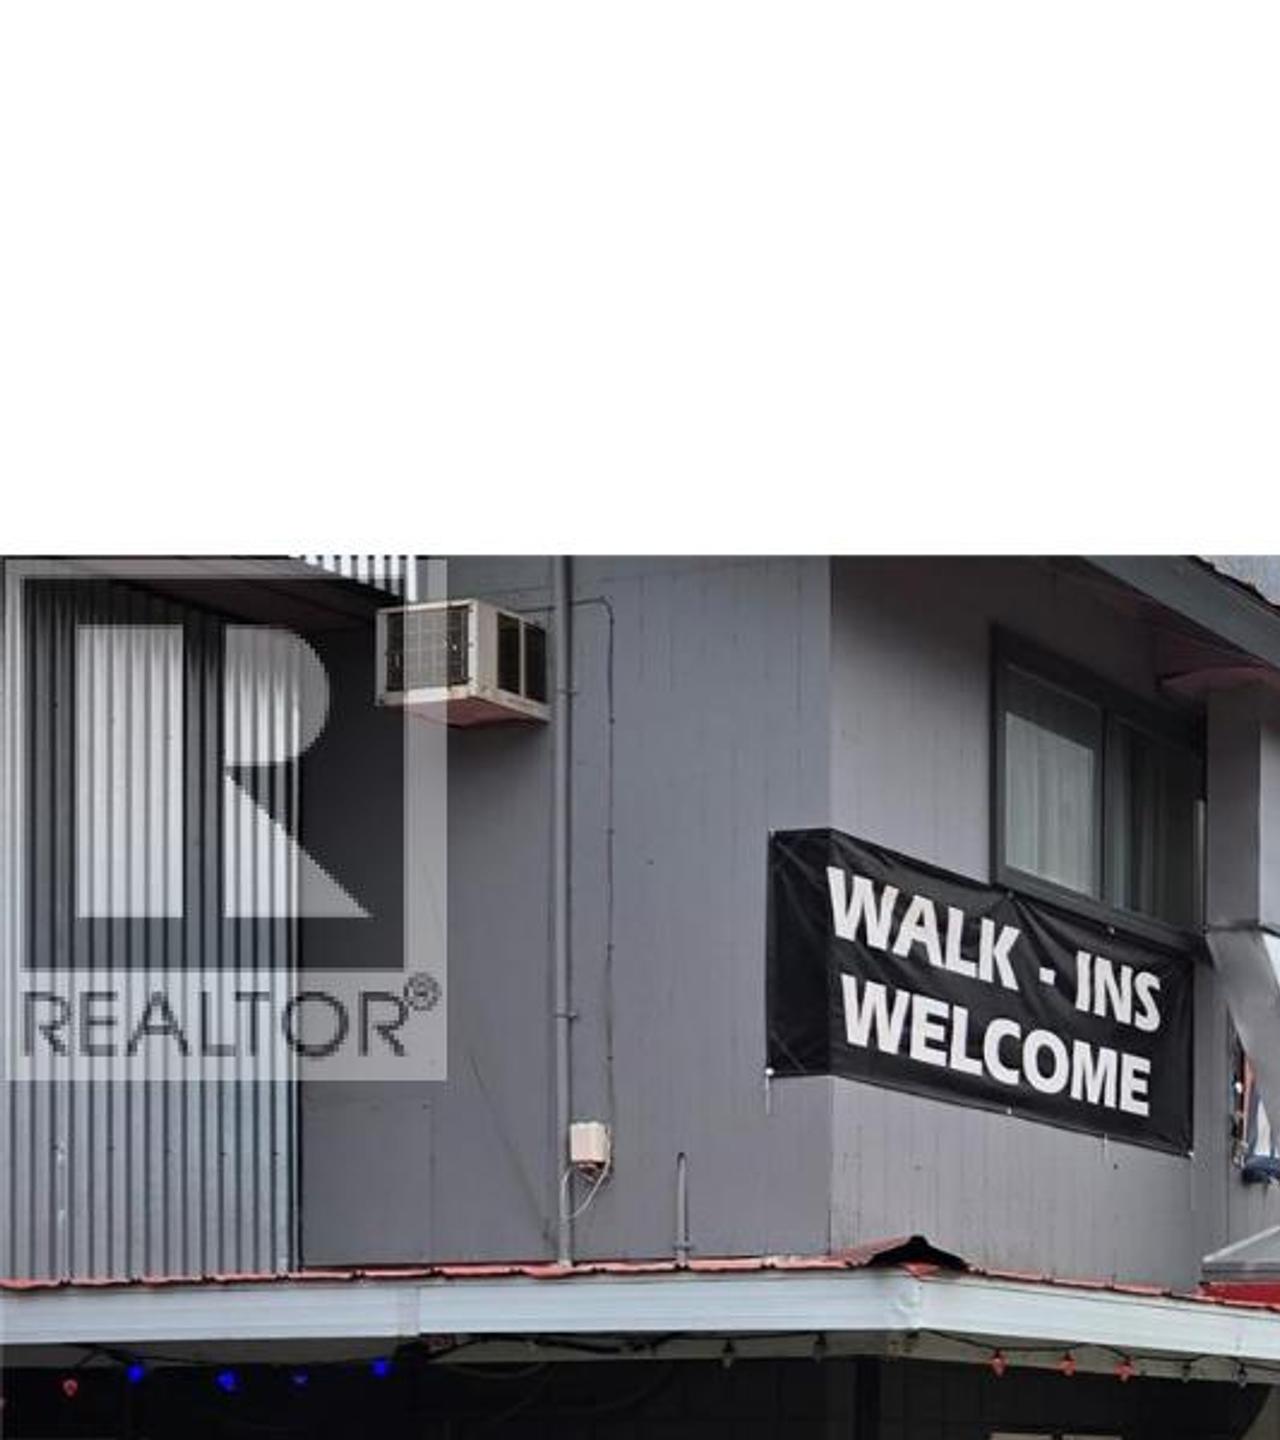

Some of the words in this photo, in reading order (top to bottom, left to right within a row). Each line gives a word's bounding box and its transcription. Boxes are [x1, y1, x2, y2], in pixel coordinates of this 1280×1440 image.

[826, 865, 1021, 991] WALK
[1075, 949, 1162, 1033] INS
[840, 973, 1153, 1117] WELCOME
